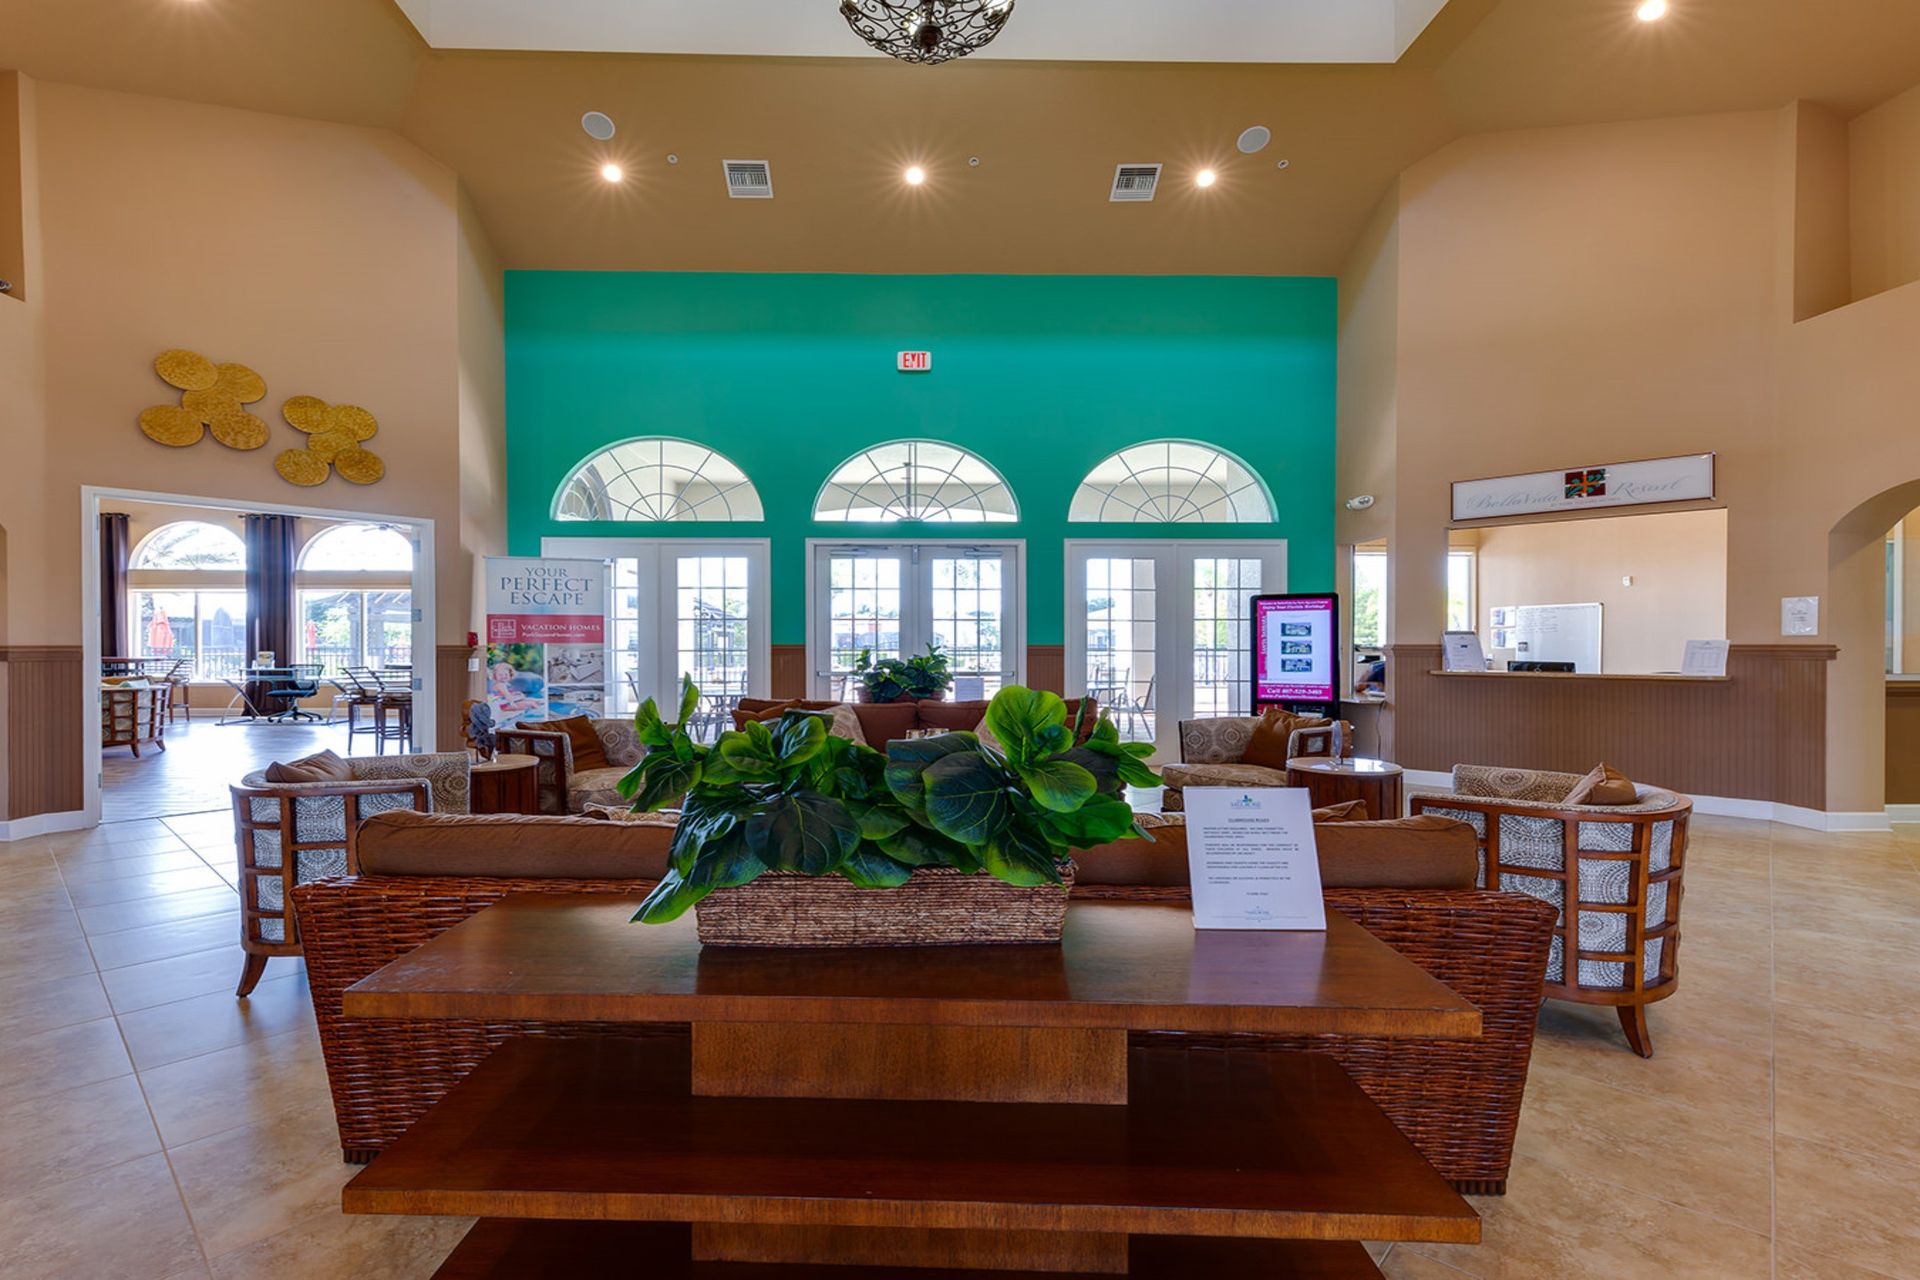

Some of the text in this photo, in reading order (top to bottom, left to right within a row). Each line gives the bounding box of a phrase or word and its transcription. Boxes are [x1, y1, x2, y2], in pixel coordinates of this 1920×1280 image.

[903, 352, 927, 368] EXIT
[1610, 476, 1693, 500] Resort
[525, 567, 569, 577] YOUR
[501, 577, 593, 592] PERFECT
[511, 591, 584, 606] ESCAPE
[521, 623, 567, 631] VACATION
